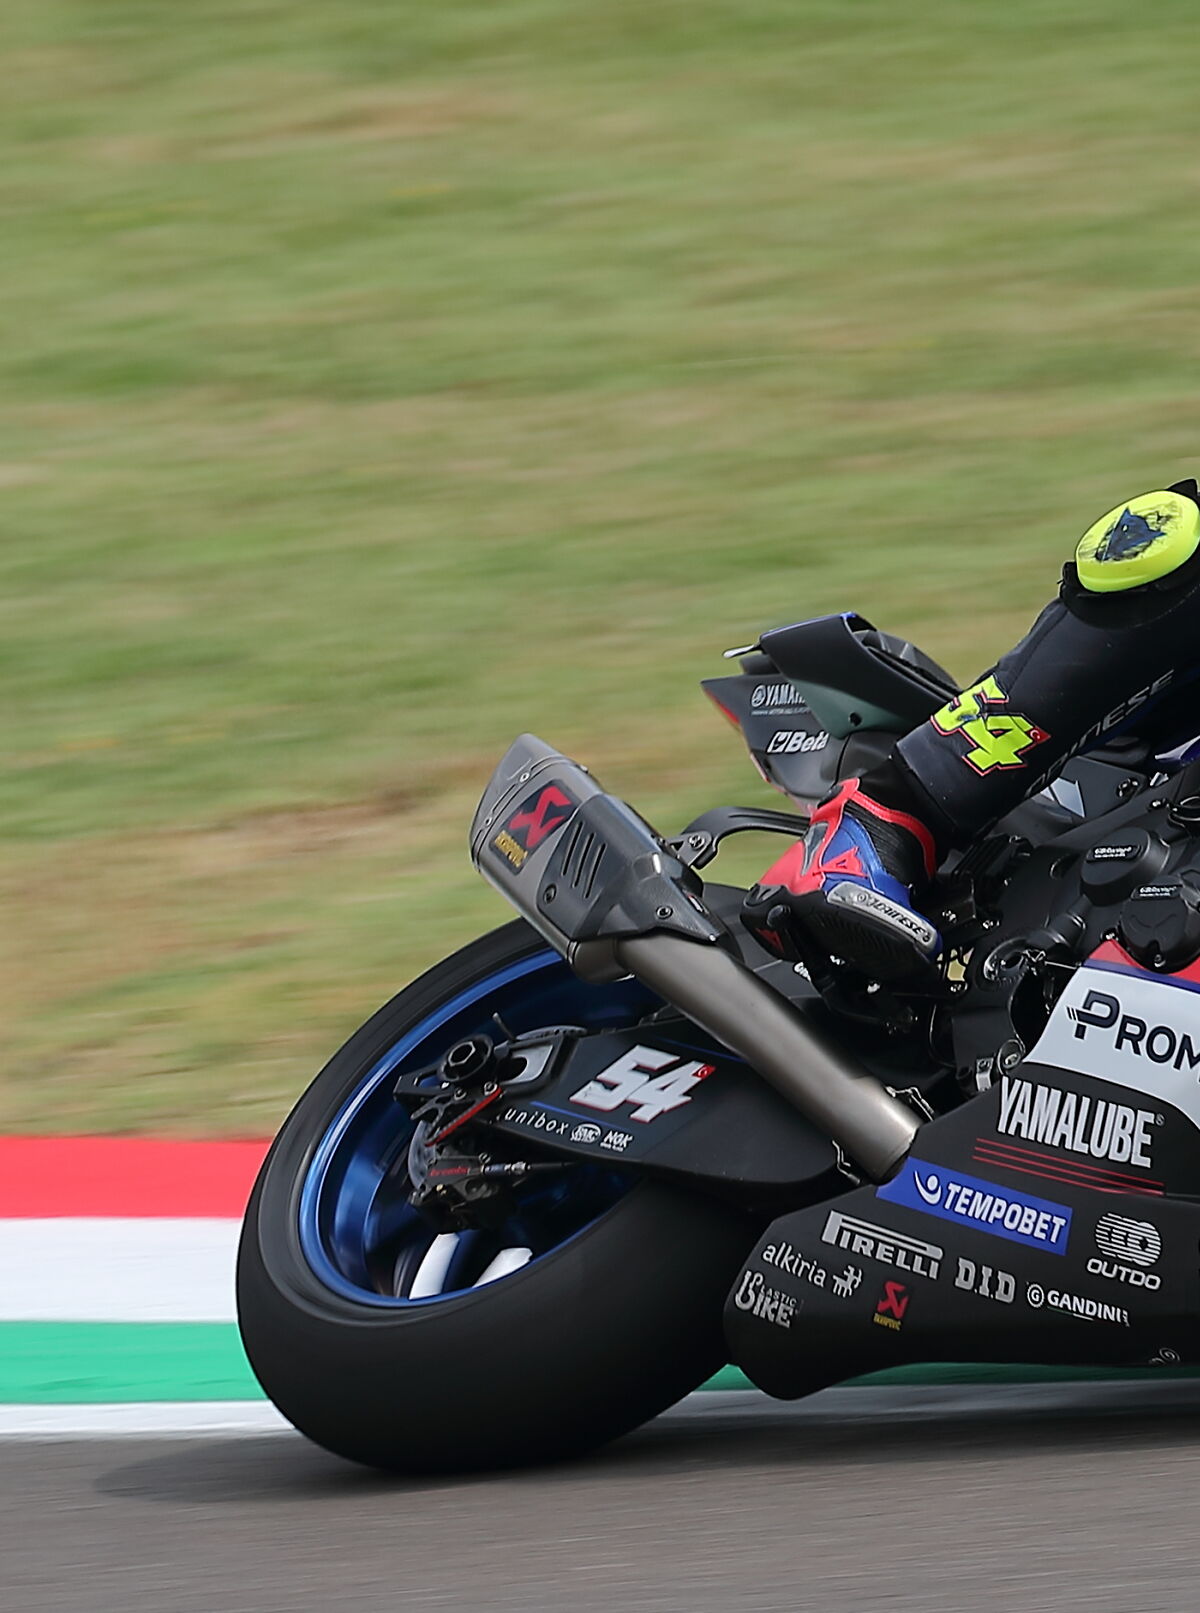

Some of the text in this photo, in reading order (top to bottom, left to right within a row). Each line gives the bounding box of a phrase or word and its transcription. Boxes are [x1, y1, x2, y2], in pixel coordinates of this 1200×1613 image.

[765, 683, 806, 706] YAMA
[930, 674, 1037, 776] 54
[569, 1044, 706, 1124] 54
[504, 1106, 569, 1136] unibox
[997, 1075, 1154, 1168] YAMALUBE
[943, 1182, 1067, 1244] TEMPOBET
[762, 1241, 827, 1288] alkiria
[821, 1210, 944, 1280] PIRELLI
[1086, 1257, 1161, 1290] OUTDO
[1047, 1289, 1122, 1324] GANDINI
